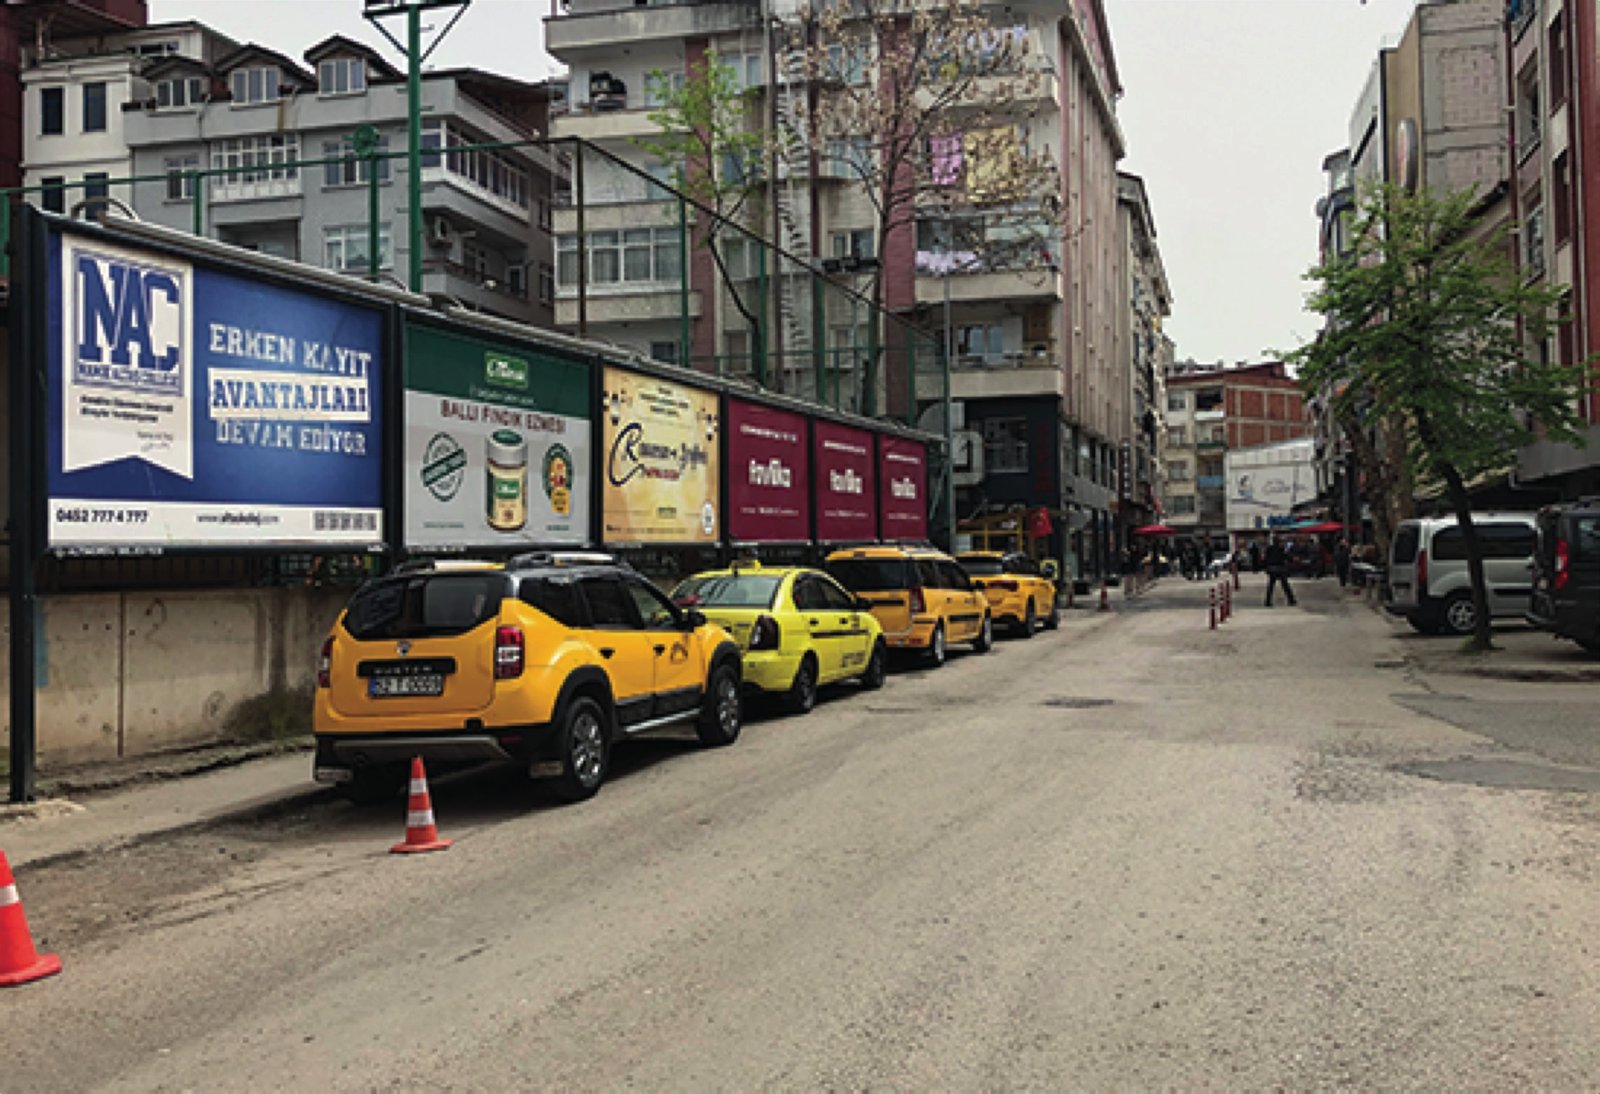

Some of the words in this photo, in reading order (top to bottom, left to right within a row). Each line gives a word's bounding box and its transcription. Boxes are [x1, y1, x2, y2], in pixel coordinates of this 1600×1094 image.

[209, 322, 296, 365] ERKEN
[303, 340, 372, 378] KAYIT
[212, 378, 367, 413] AVANTAJLARI
[215, 418, 294, 448] DEVAM
